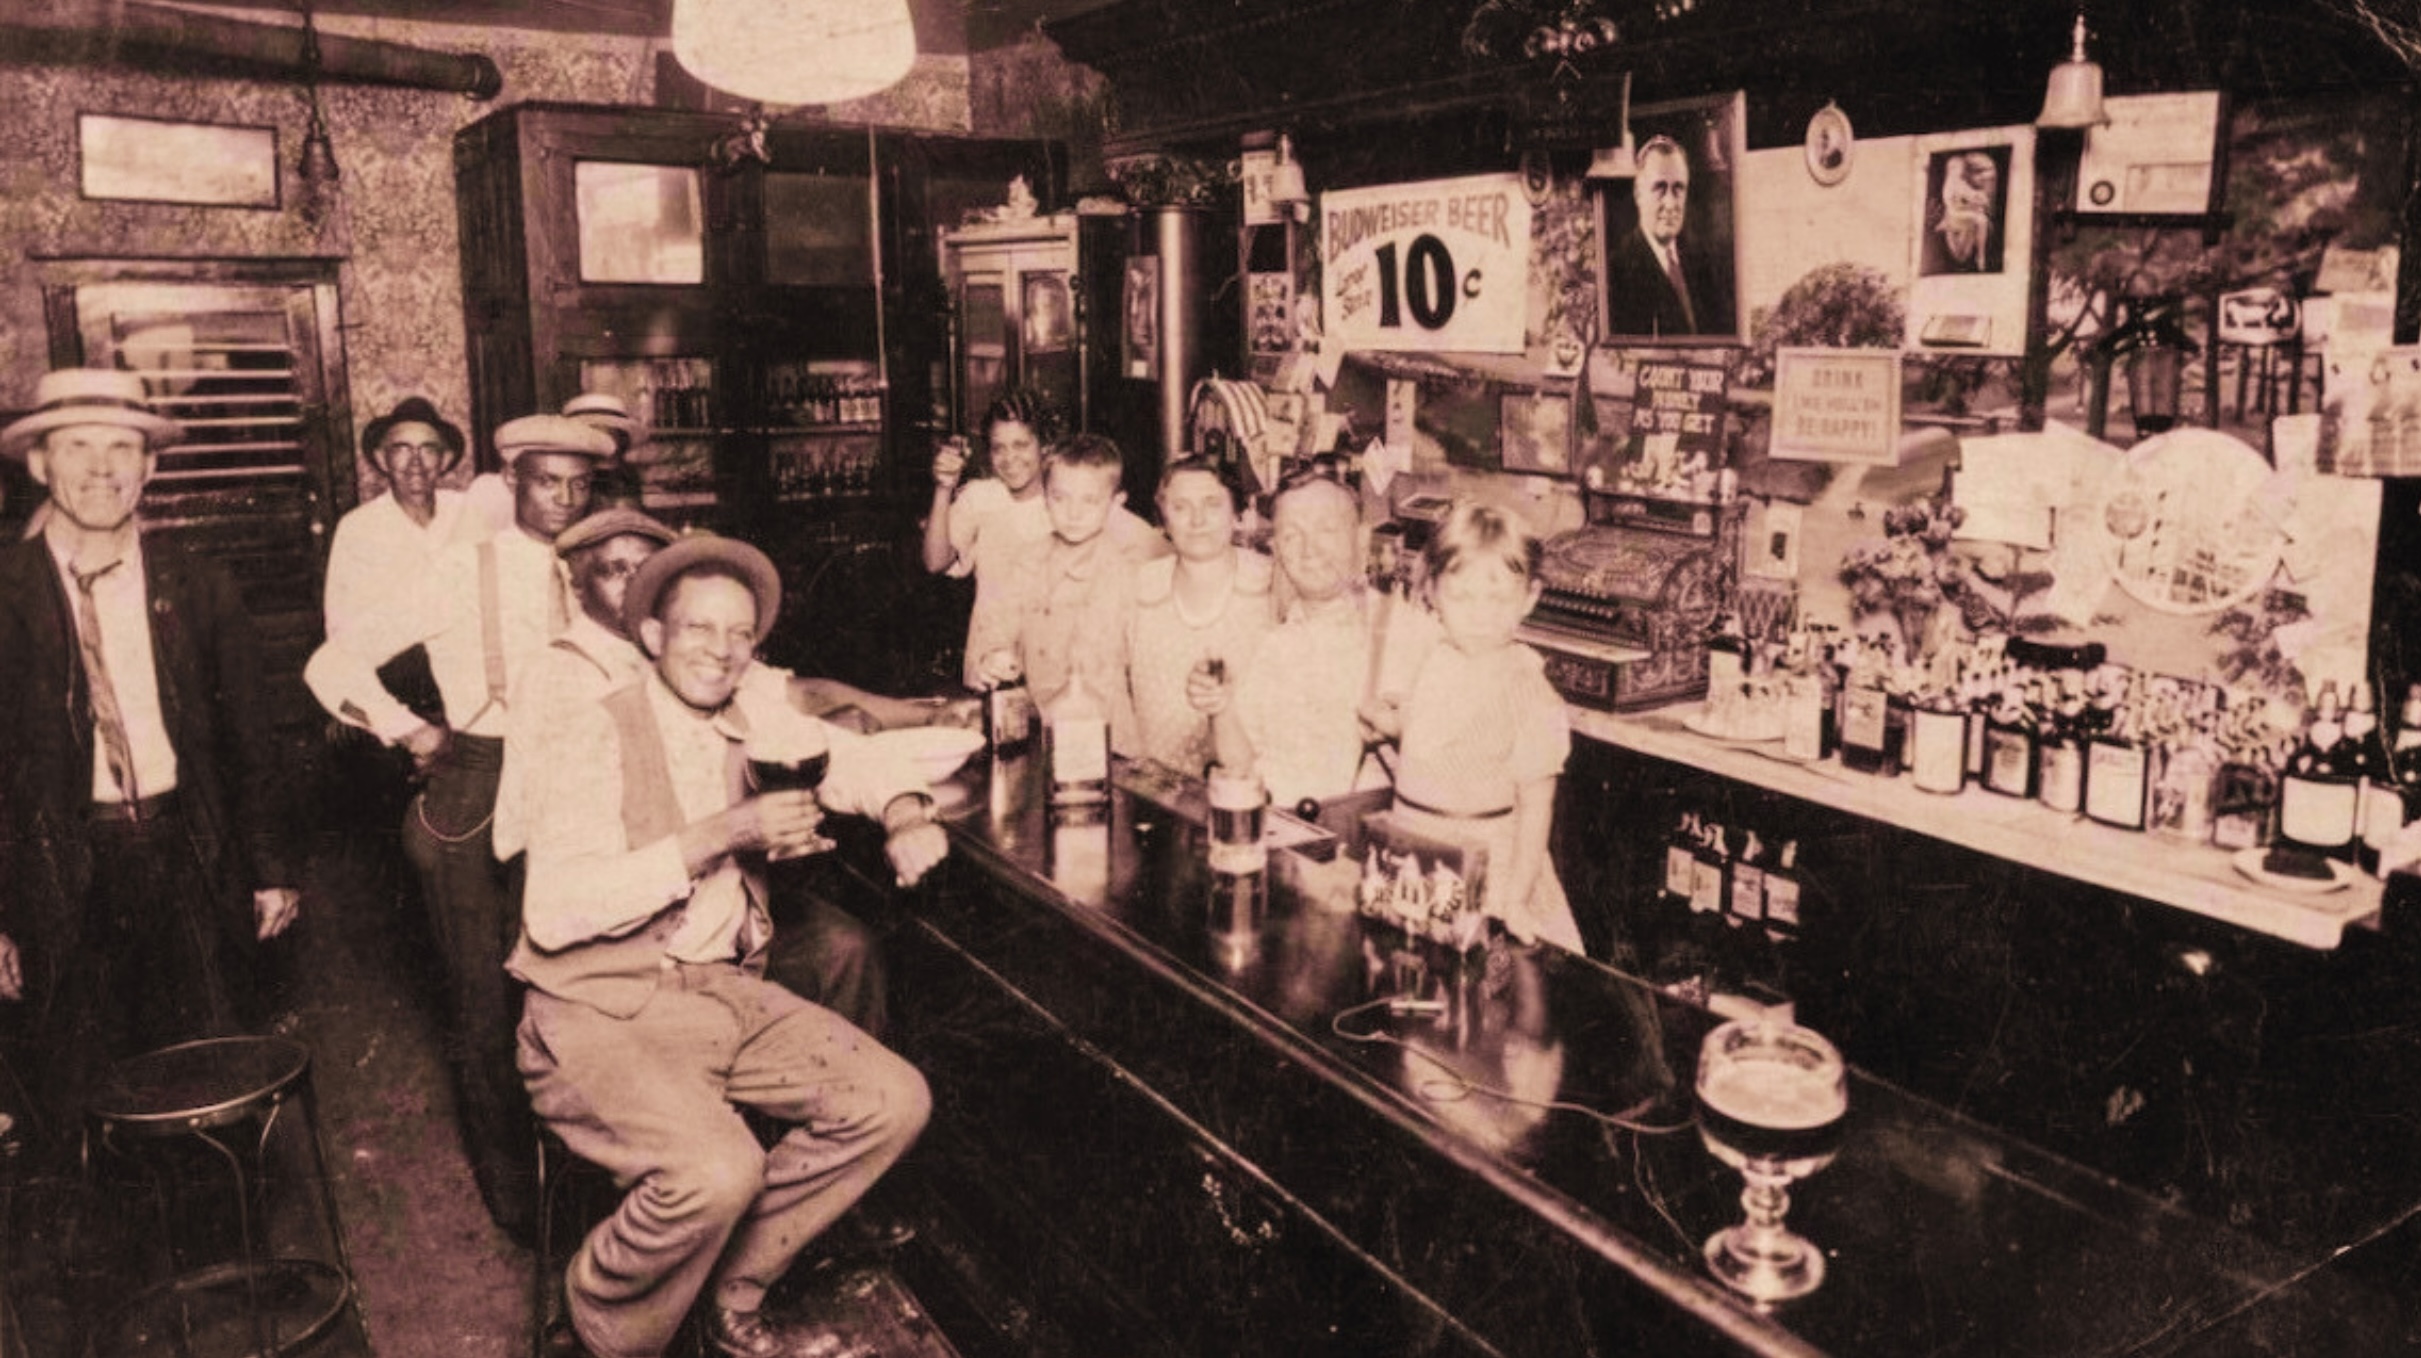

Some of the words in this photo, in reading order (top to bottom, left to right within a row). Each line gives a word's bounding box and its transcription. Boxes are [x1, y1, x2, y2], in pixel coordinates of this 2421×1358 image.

[1327, 200, 1440, 265] BUDWEISER
[1447, 192, 1511, 249] BEER
[1639, 366, 1685, 388] COUNT
[1633, 408, 1653, 428] AS
[1683, 413, 1715, 433] GET
